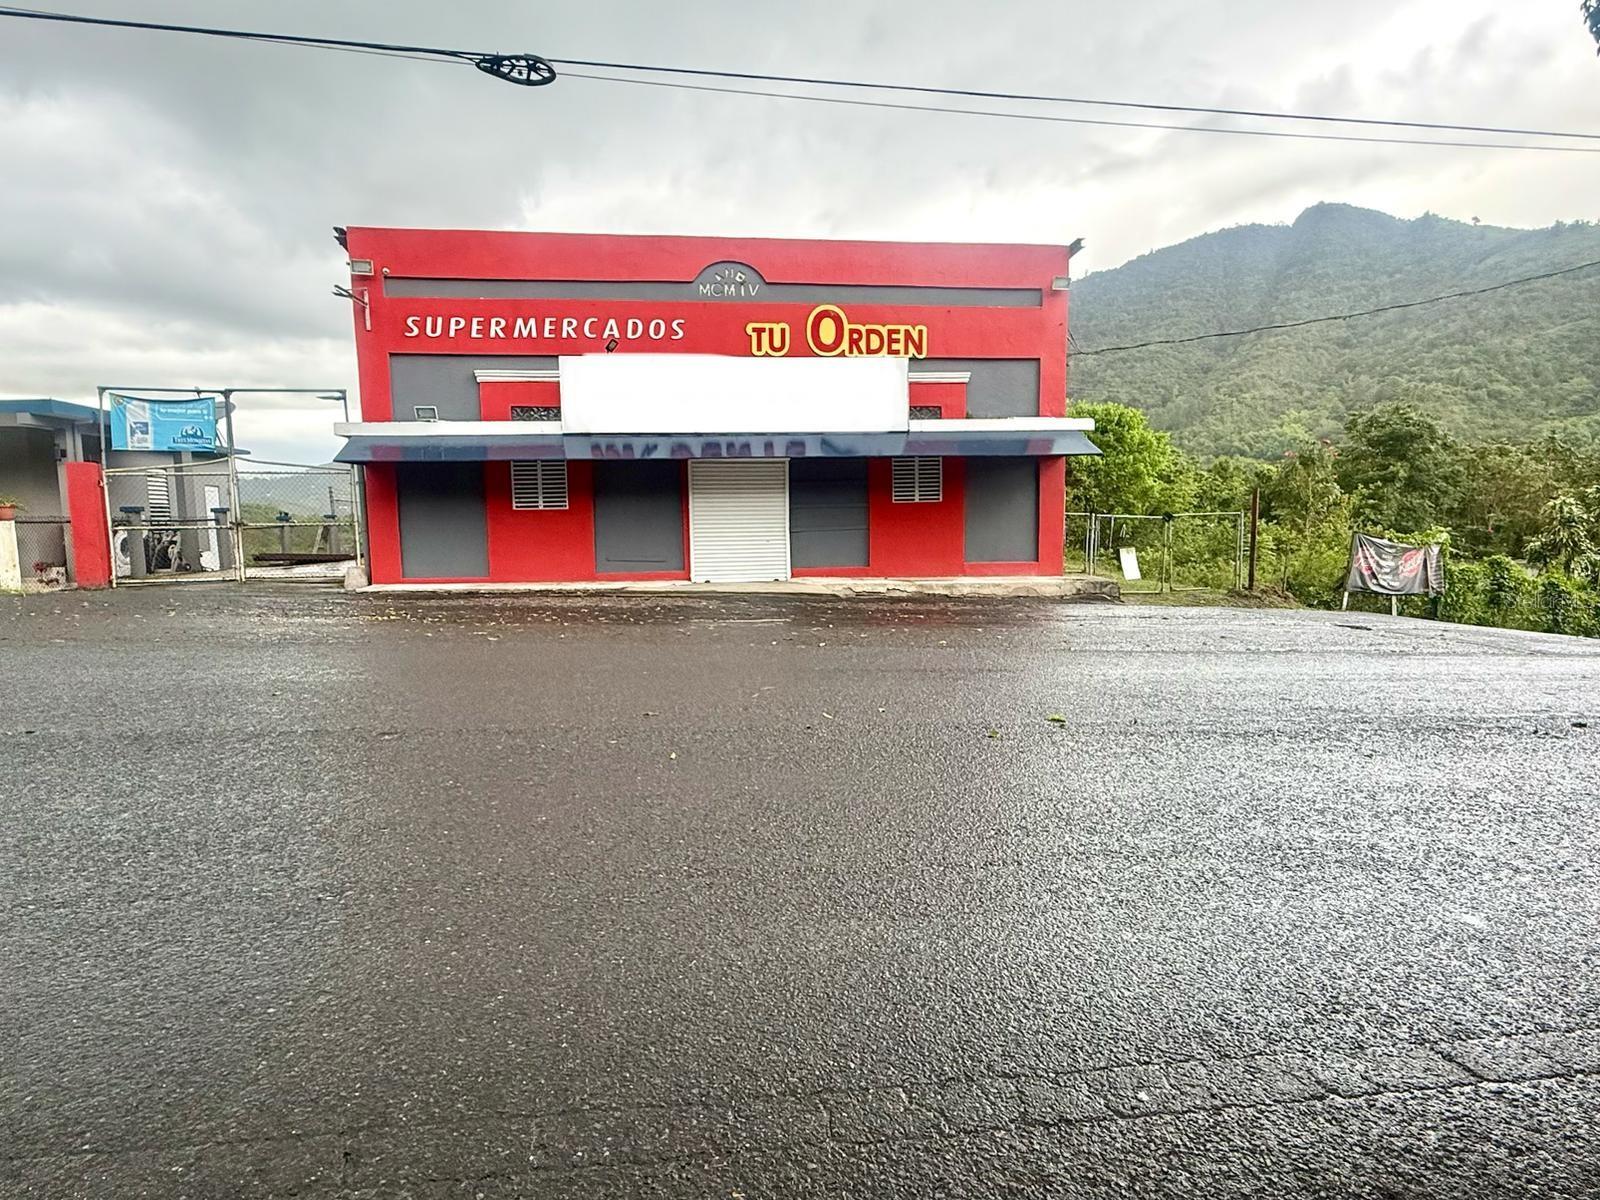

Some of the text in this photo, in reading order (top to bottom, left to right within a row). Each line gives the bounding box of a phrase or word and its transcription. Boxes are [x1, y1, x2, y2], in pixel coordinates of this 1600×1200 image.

[404, 303, 928, 359] SUPERMERCADOS TU ORDEN
